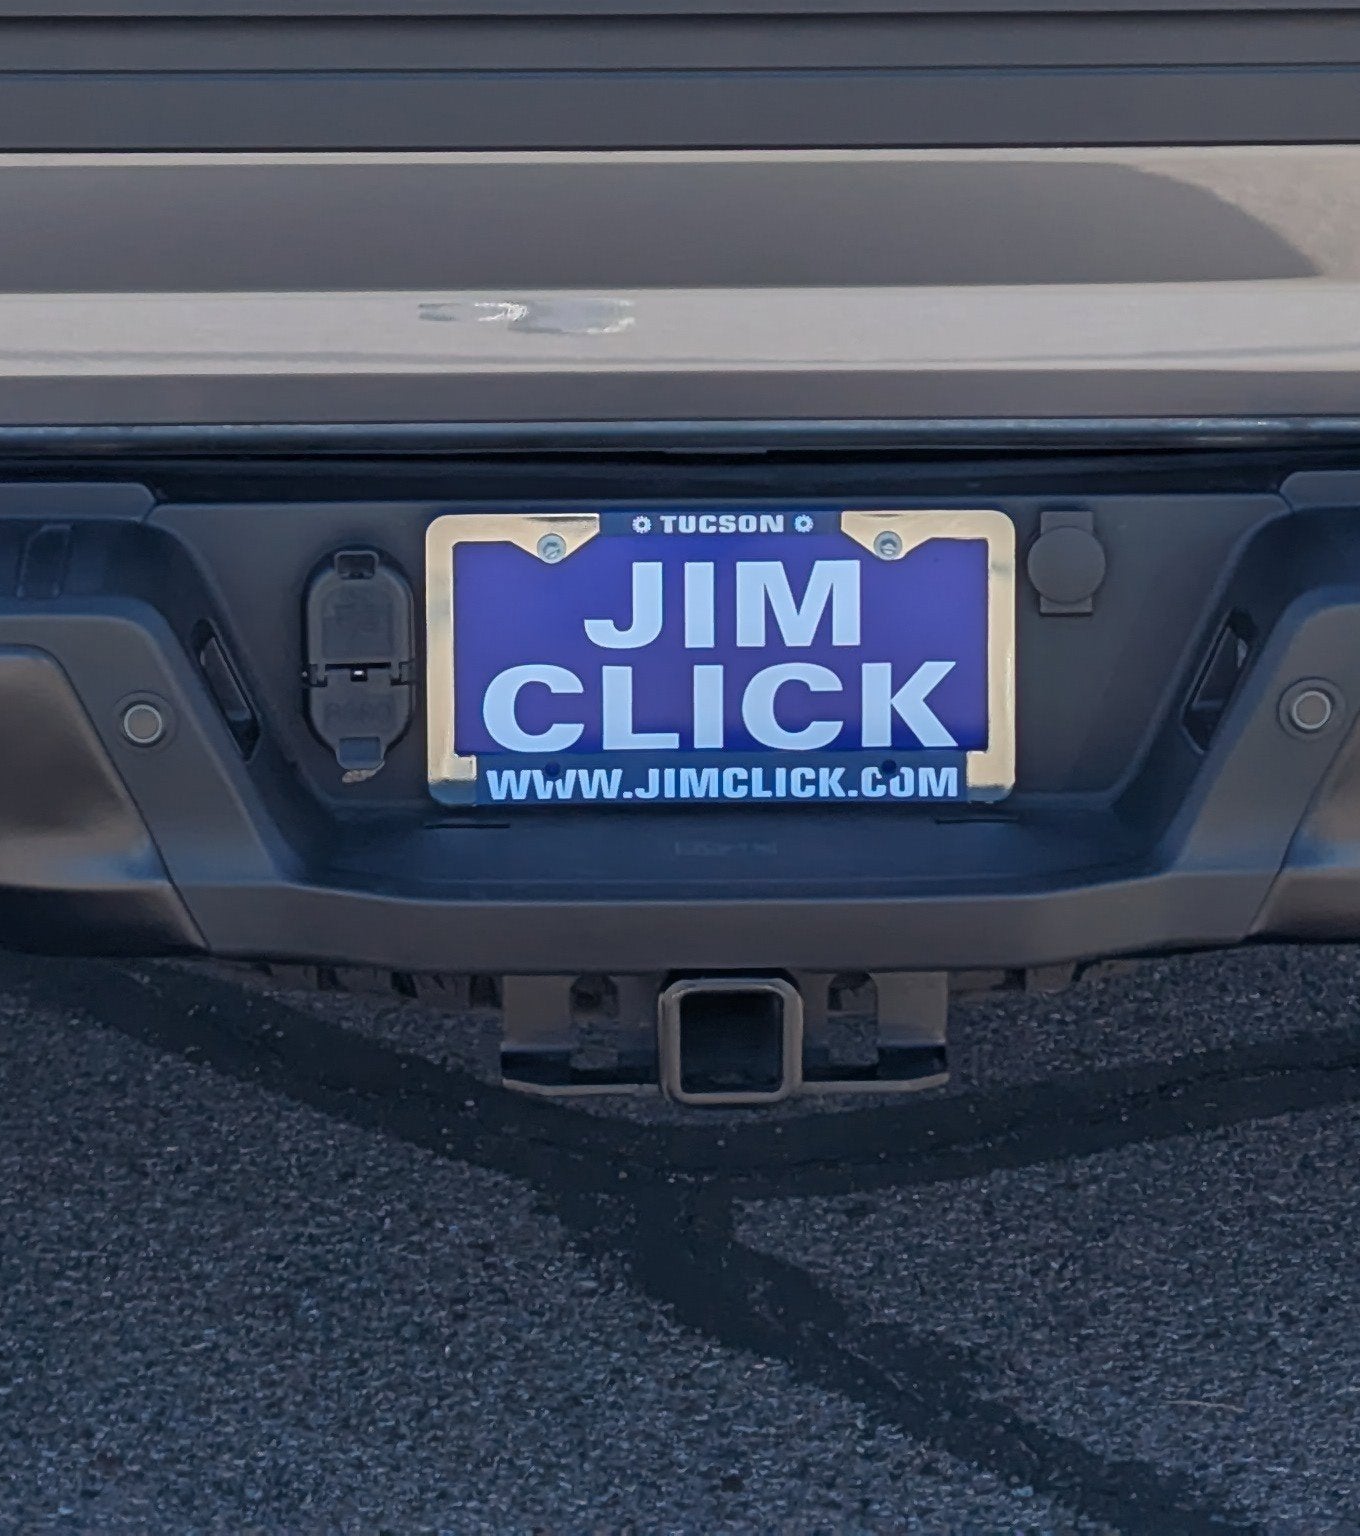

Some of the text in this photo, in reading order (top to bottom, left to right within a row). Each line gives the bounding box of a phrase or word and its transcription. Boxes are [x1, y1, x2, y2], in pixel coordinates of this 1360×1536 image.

[659, 514, 784, 534] TUCSON
[584, 559, 861, 650] JIM
[482, 661, 958, 753] CLICK
[486, 766, 958, 800] WWW.JIMCLICK.COM
